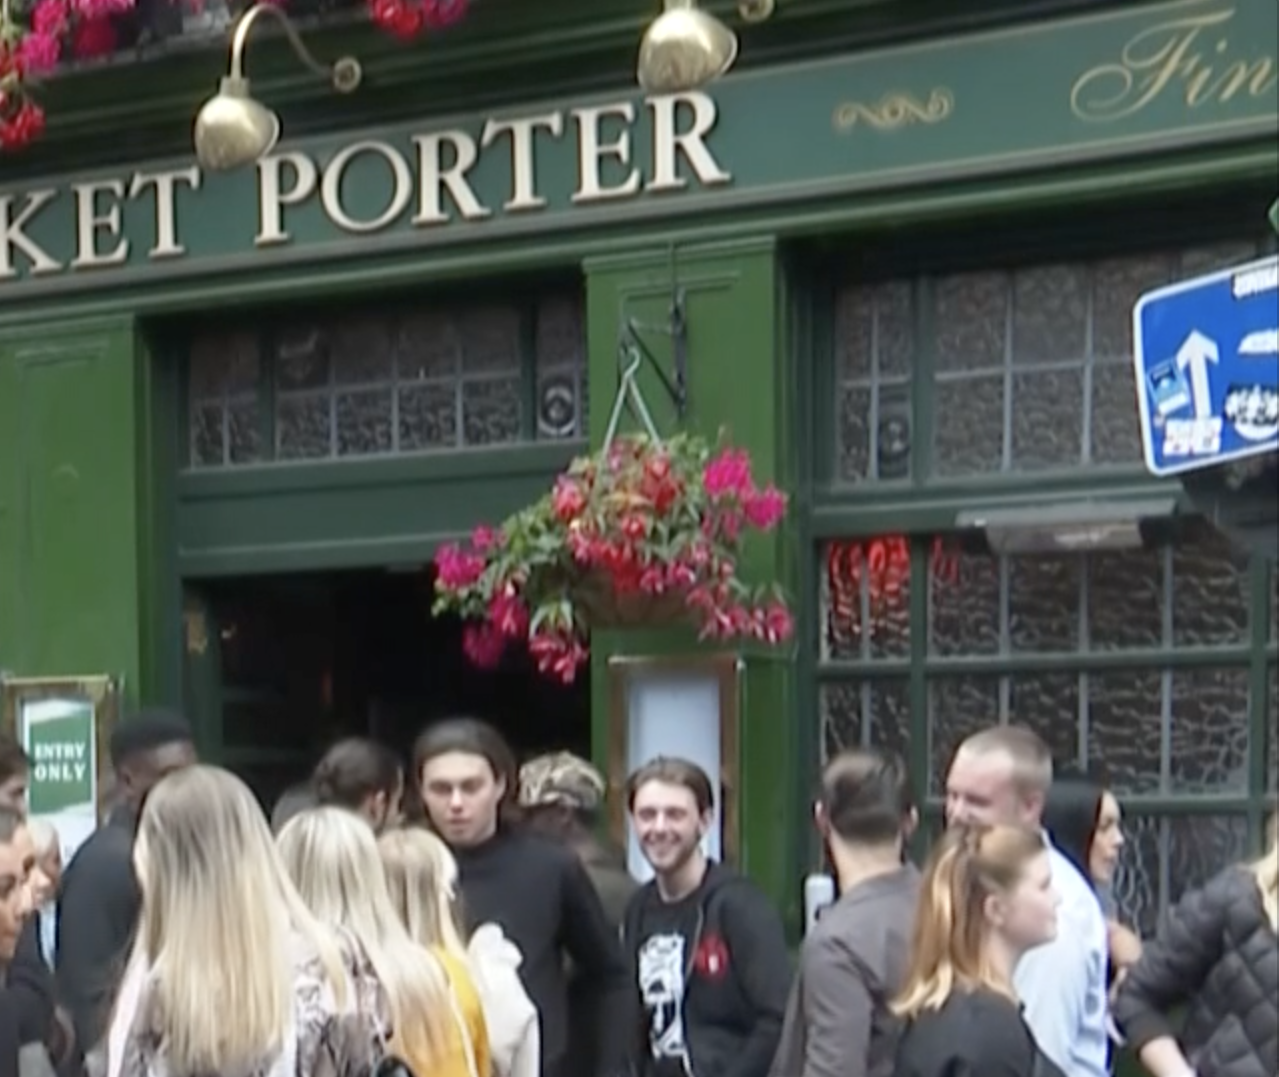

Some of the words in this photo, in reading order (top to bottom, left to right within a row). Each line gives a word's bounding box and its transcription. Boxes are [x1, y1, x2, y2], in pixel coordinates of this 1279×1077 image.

[254, 91, 732, 247] PORTER
[34, 742, 86, 761] ENTRY
[34, 763, 86, 782] ONLY
